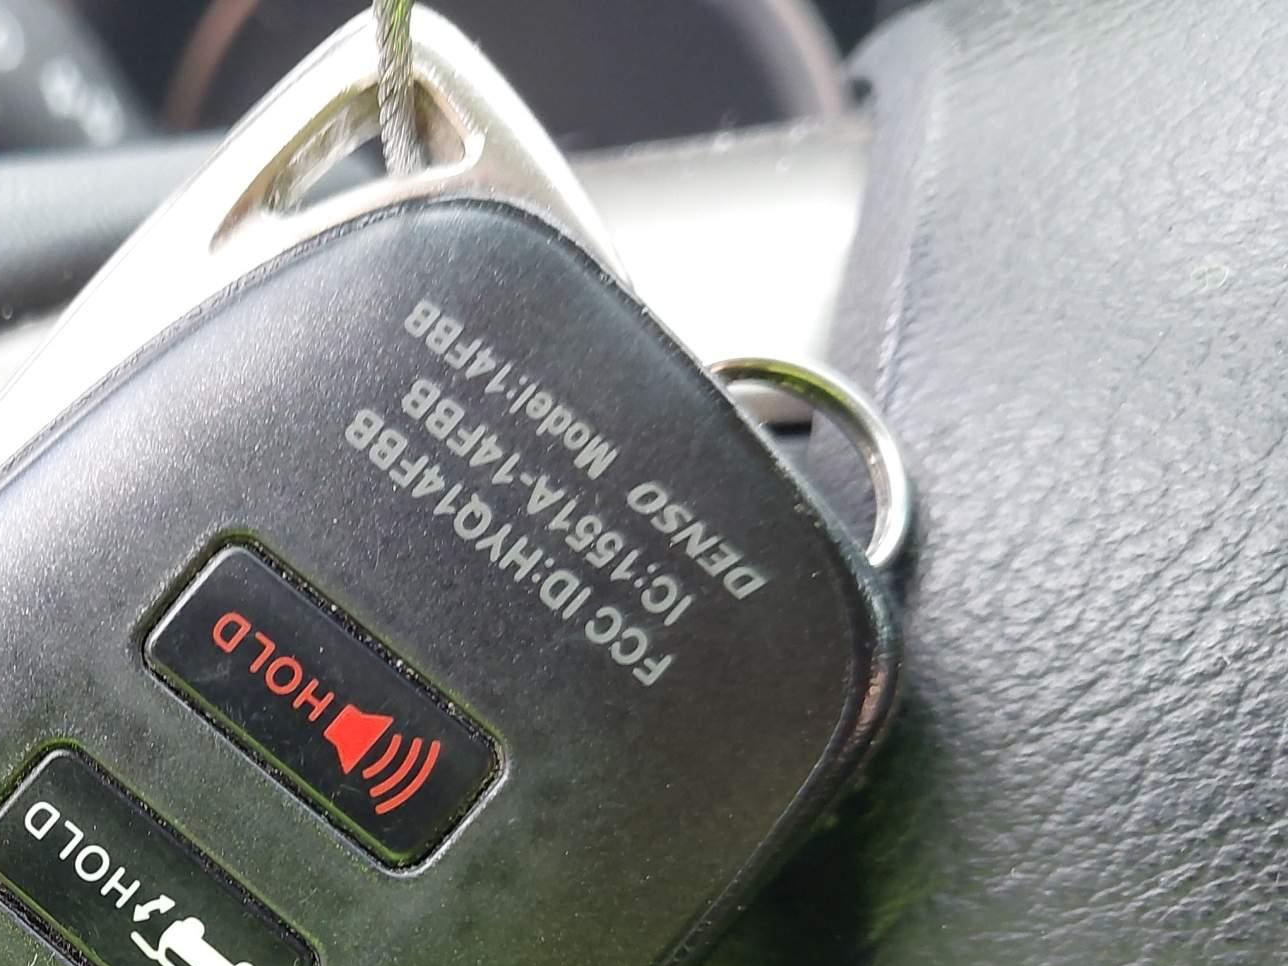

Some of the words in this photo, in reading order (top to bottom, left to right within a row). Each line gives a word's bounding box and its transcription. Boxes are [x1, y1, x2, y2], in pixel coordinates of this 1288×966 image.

[404, 300, 619, 481] Model:14FBB
[345, 408, 593, 620] ID:HYQ14FBB
[400, 379, 693, 627] IC:1551A-14FBB
[626, 481, 769, 600] DENSO
[212, 611, 335, 722] HOLD
[584, 606, 673, 687] FCC
[24, 800, 141, 909] HOLD
